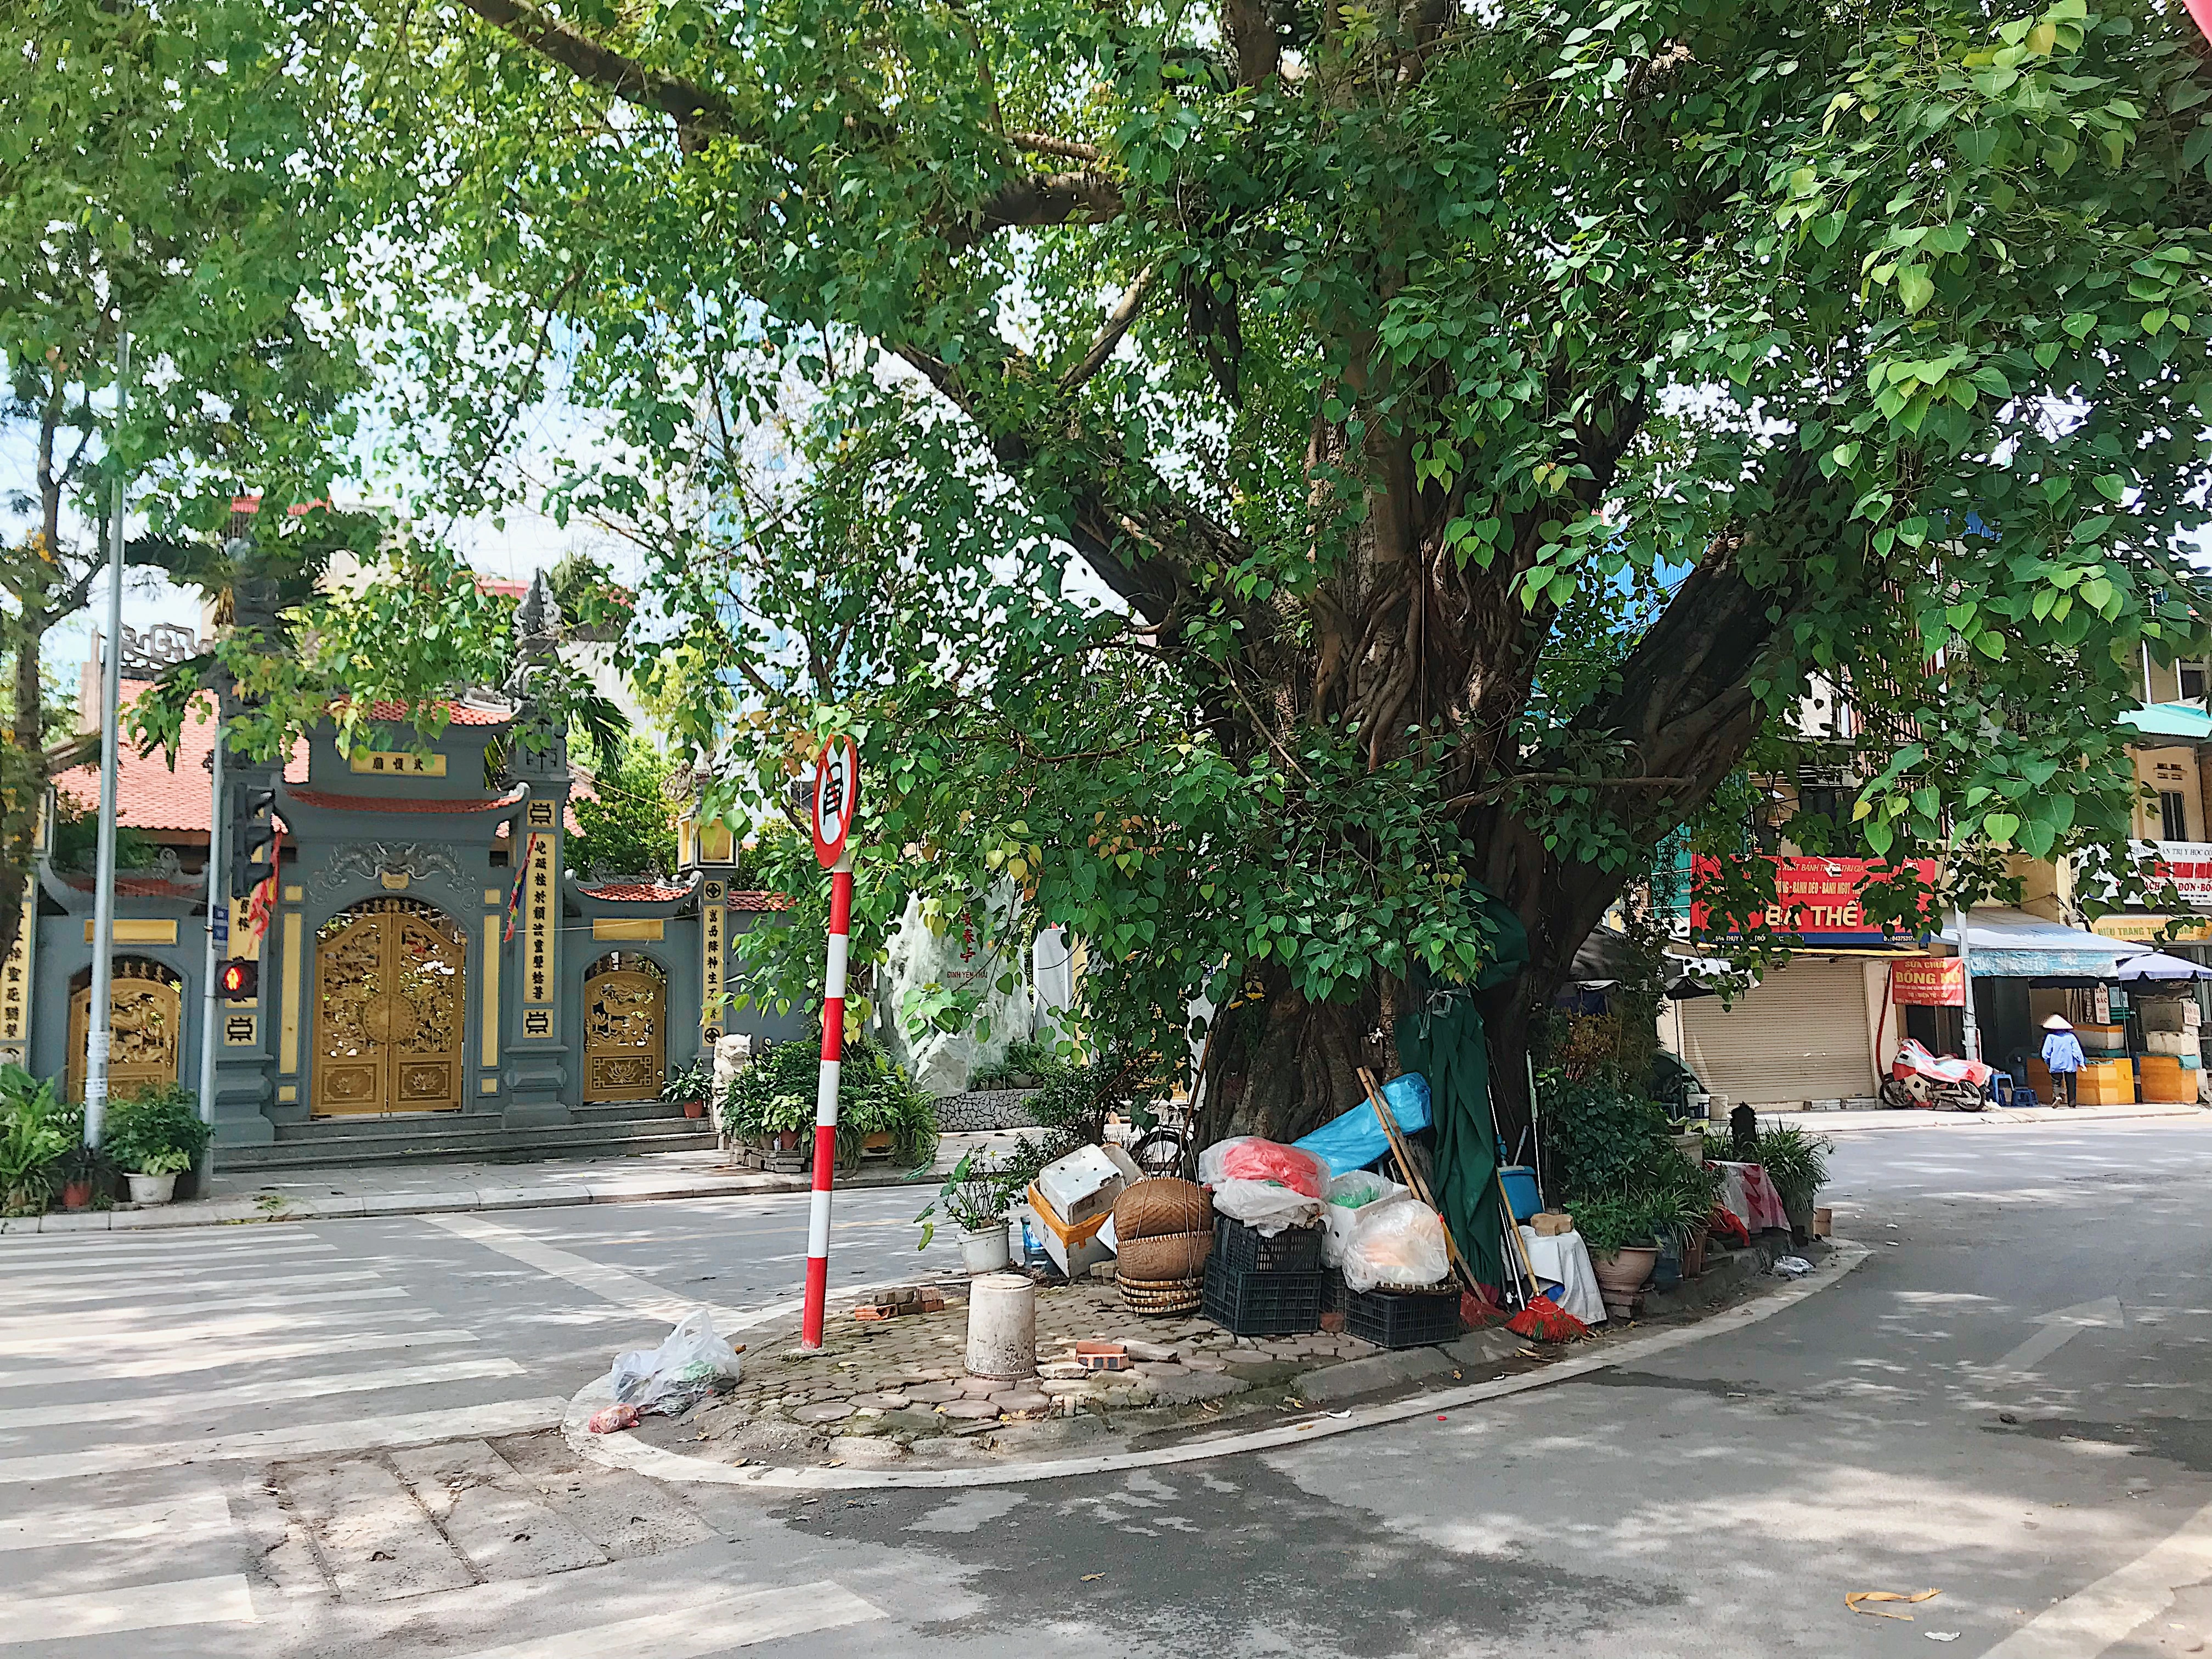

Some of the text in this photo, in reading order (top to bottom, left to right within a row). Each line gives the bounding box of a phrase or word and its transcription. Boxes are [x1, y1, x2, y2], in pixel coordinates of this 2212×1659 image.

[1801, 861, 1819, 872] BÁNH
[1793, 878, 1808, 894] BÁNH
[1822, 879, 1836, 894] BÁNH
[1895, 968, 1936, 984] ĐỒNG
